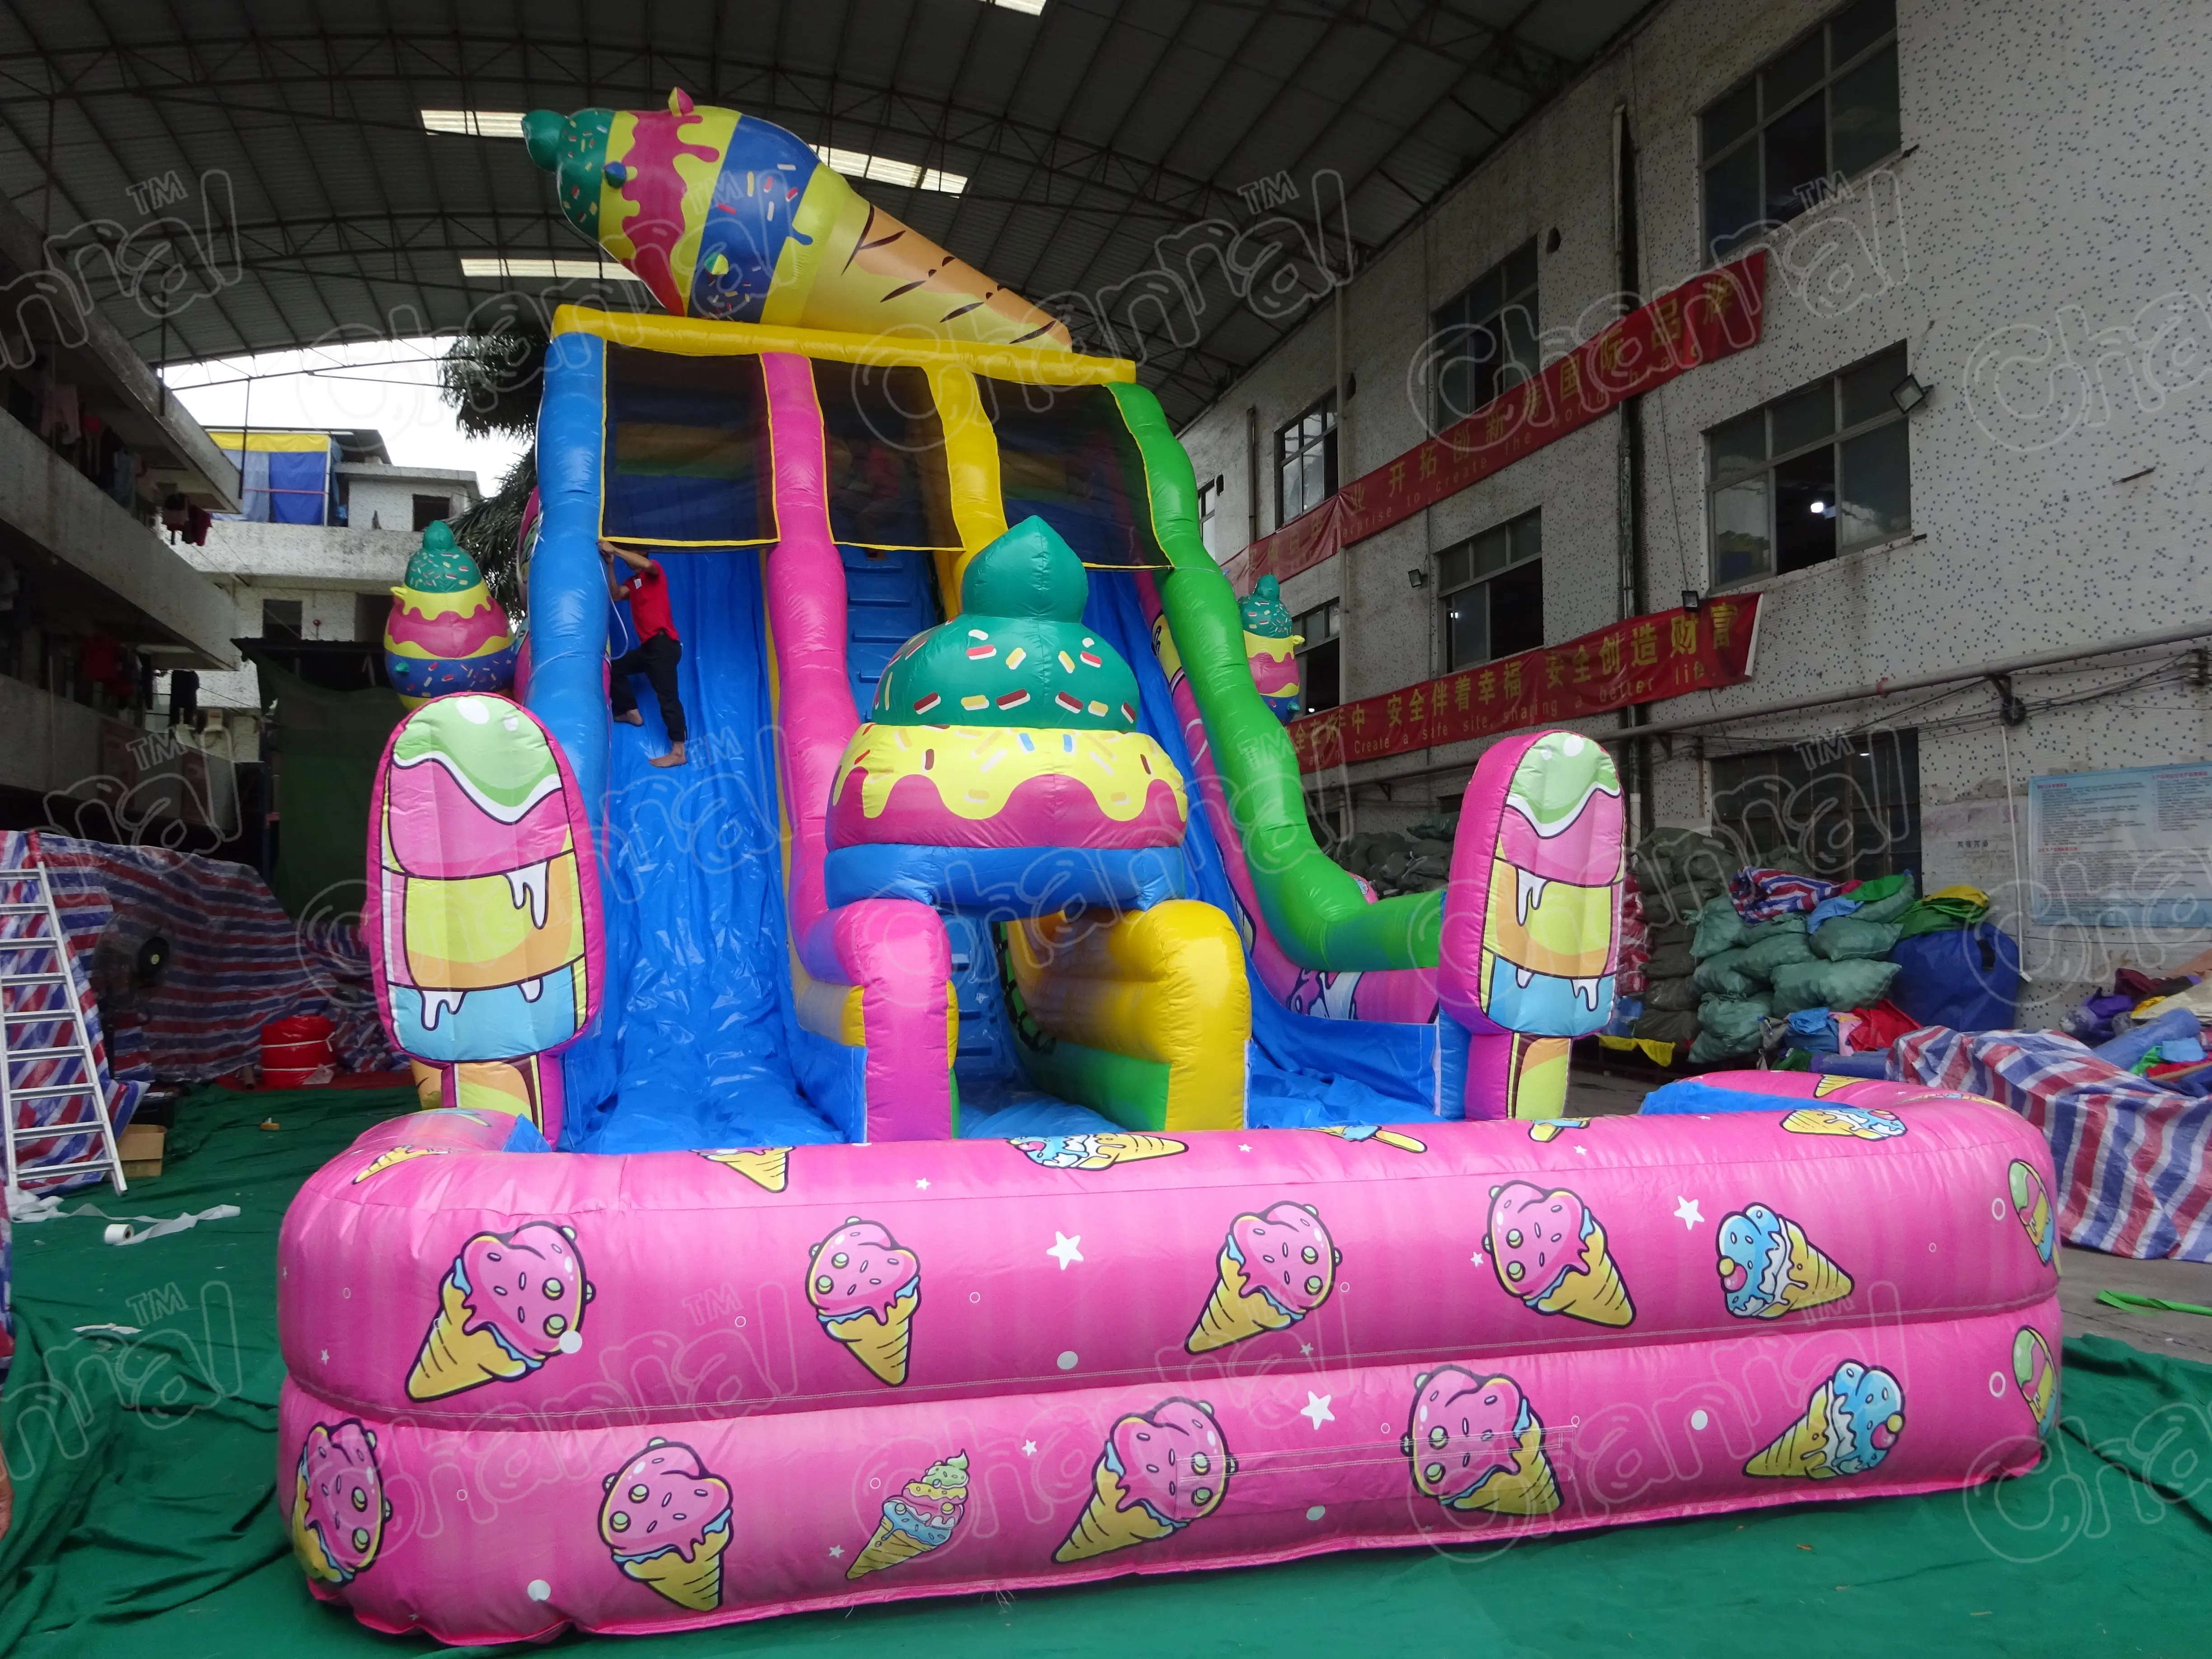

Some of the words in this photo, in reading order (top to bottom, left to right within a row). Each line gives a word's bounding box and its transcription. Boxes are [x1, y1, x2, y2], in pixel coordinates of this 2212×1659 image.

[1407, 492, 1420, 506] to
[1436, 457, 1486, 492] create
[1504, 432, 1531, 455] the
[1551, 384, 1606, 429] world
[1546, 602, 1737, 689] 安全创造财富
[1354, 736, 1390, 754] Create
[1403, 733, 1409, 745] a
[1423, 722, 1448, 740] safe
[1463, 715, 1493, 733] site,
[1503, 698, 1557, 723] sharing
[1575, 693, 1583, 708] a
[1599, 678, 1654, 703] better
